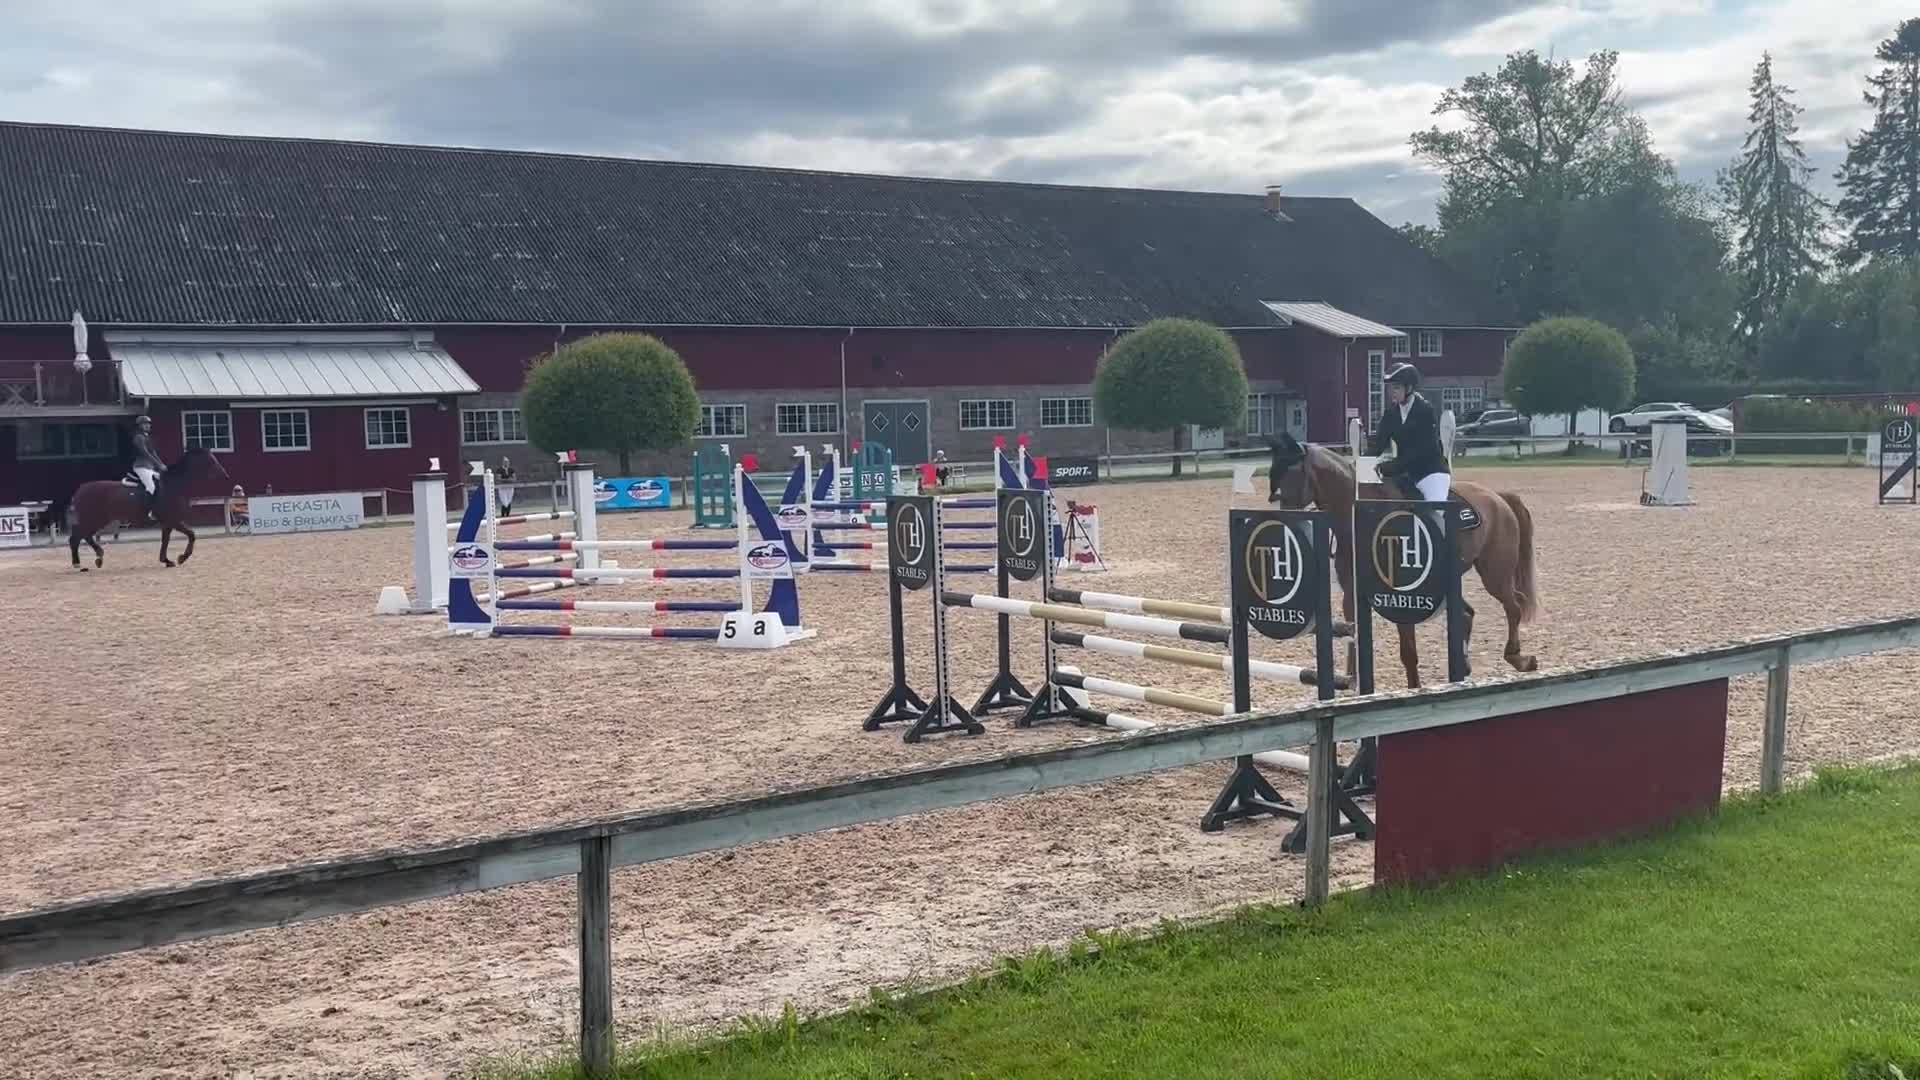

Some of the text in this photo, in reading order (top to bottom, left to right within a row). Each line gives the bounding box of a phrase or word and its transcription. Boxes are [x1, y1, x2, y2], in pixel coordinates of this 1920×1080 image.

[1056, 466, 1088, 477] SPORT
[271, 499, 342, 513] REKASTA
[254, 514, 360, 528] BED & BREAKFAST
[1005, 557, 1037, 570] STABLES
[897, 566, 928, 580] STABLES
[1373, 593, 1435, 611] STABLES
[1249, 606, 1305, 625] STABLES
[724, 620, 766, 639] 5 a
